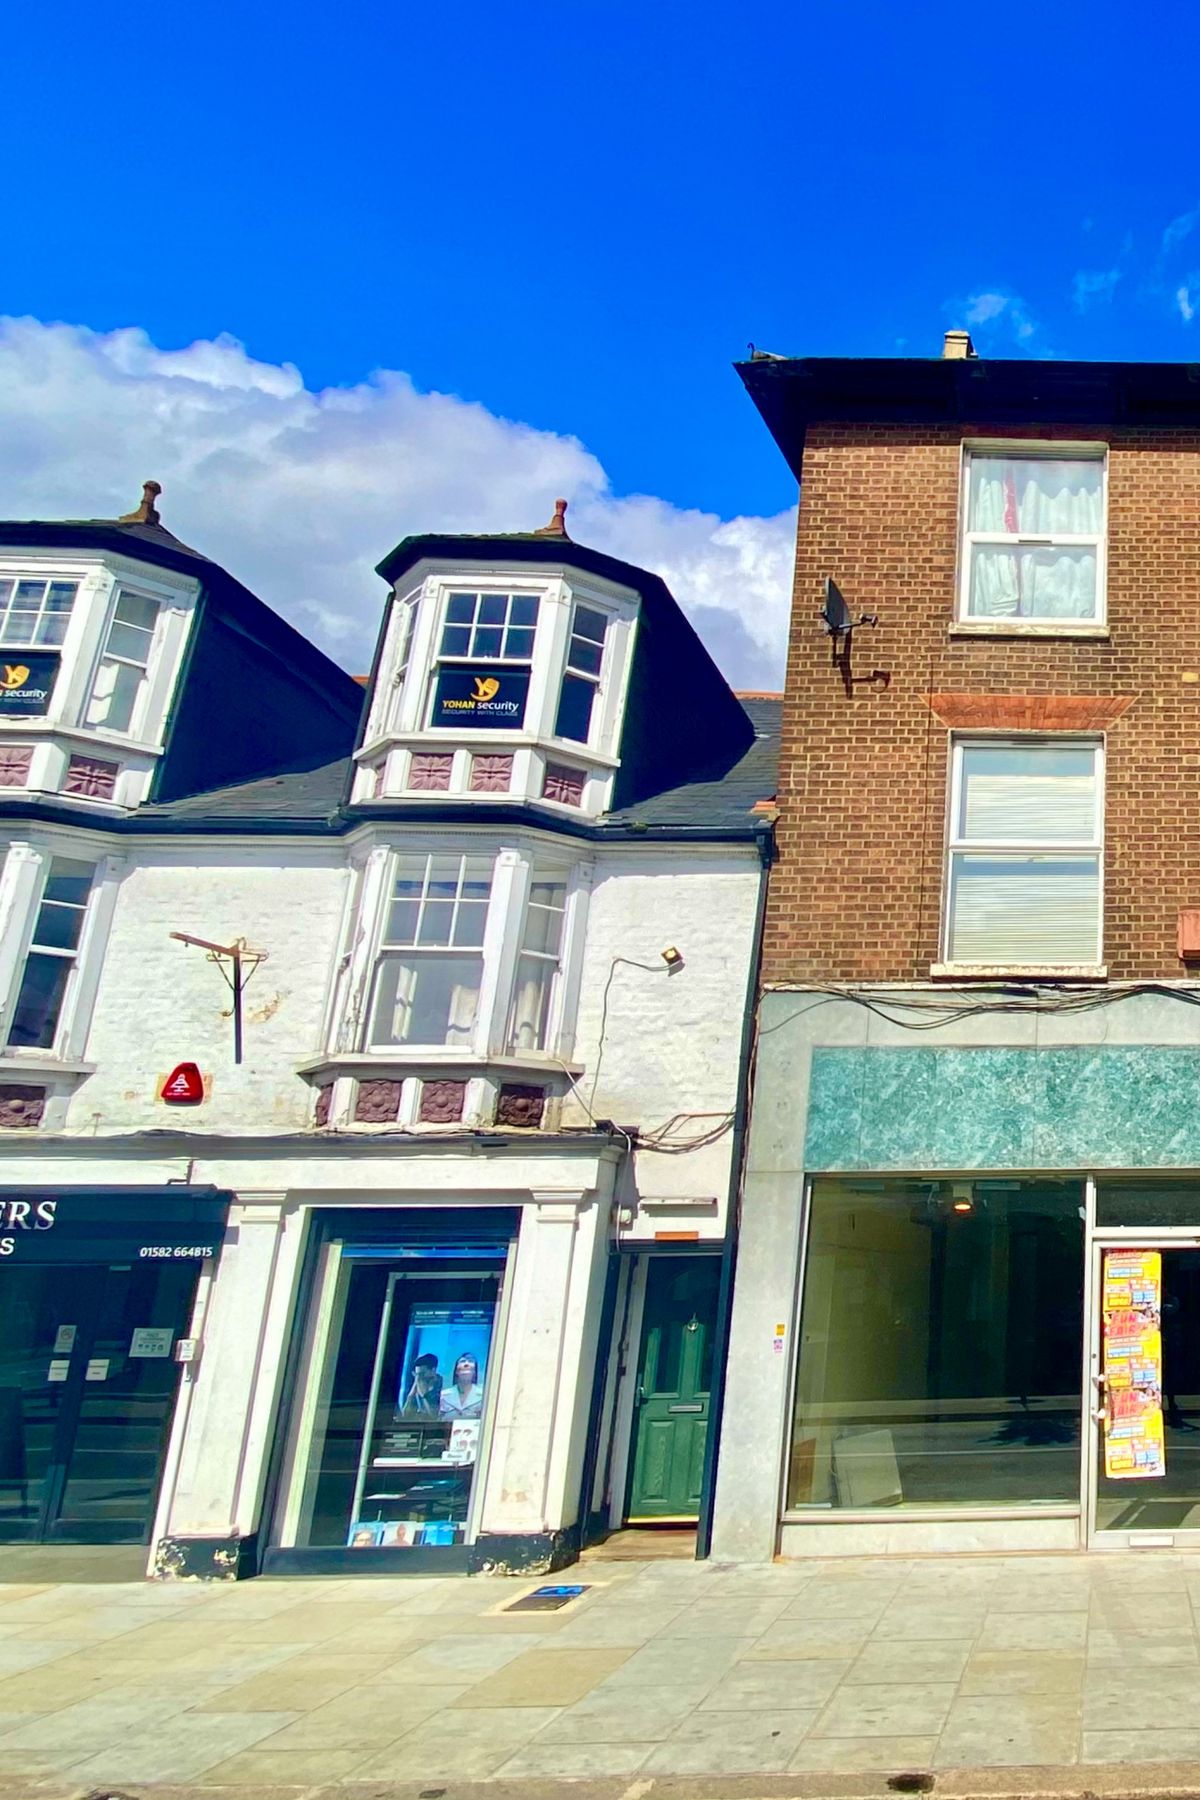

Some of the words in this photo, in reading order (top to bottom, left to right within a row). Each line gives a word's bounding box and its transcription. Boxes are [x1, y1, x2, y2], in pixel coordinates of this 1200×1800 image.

[5, 689, 48, 700] security
[442, 701, 475, 709] YOHAN
[477, 702, 519, 713] security
[140, 1247, 172, 1257] 01582
[173, 1247, 213, 1257] 664815
